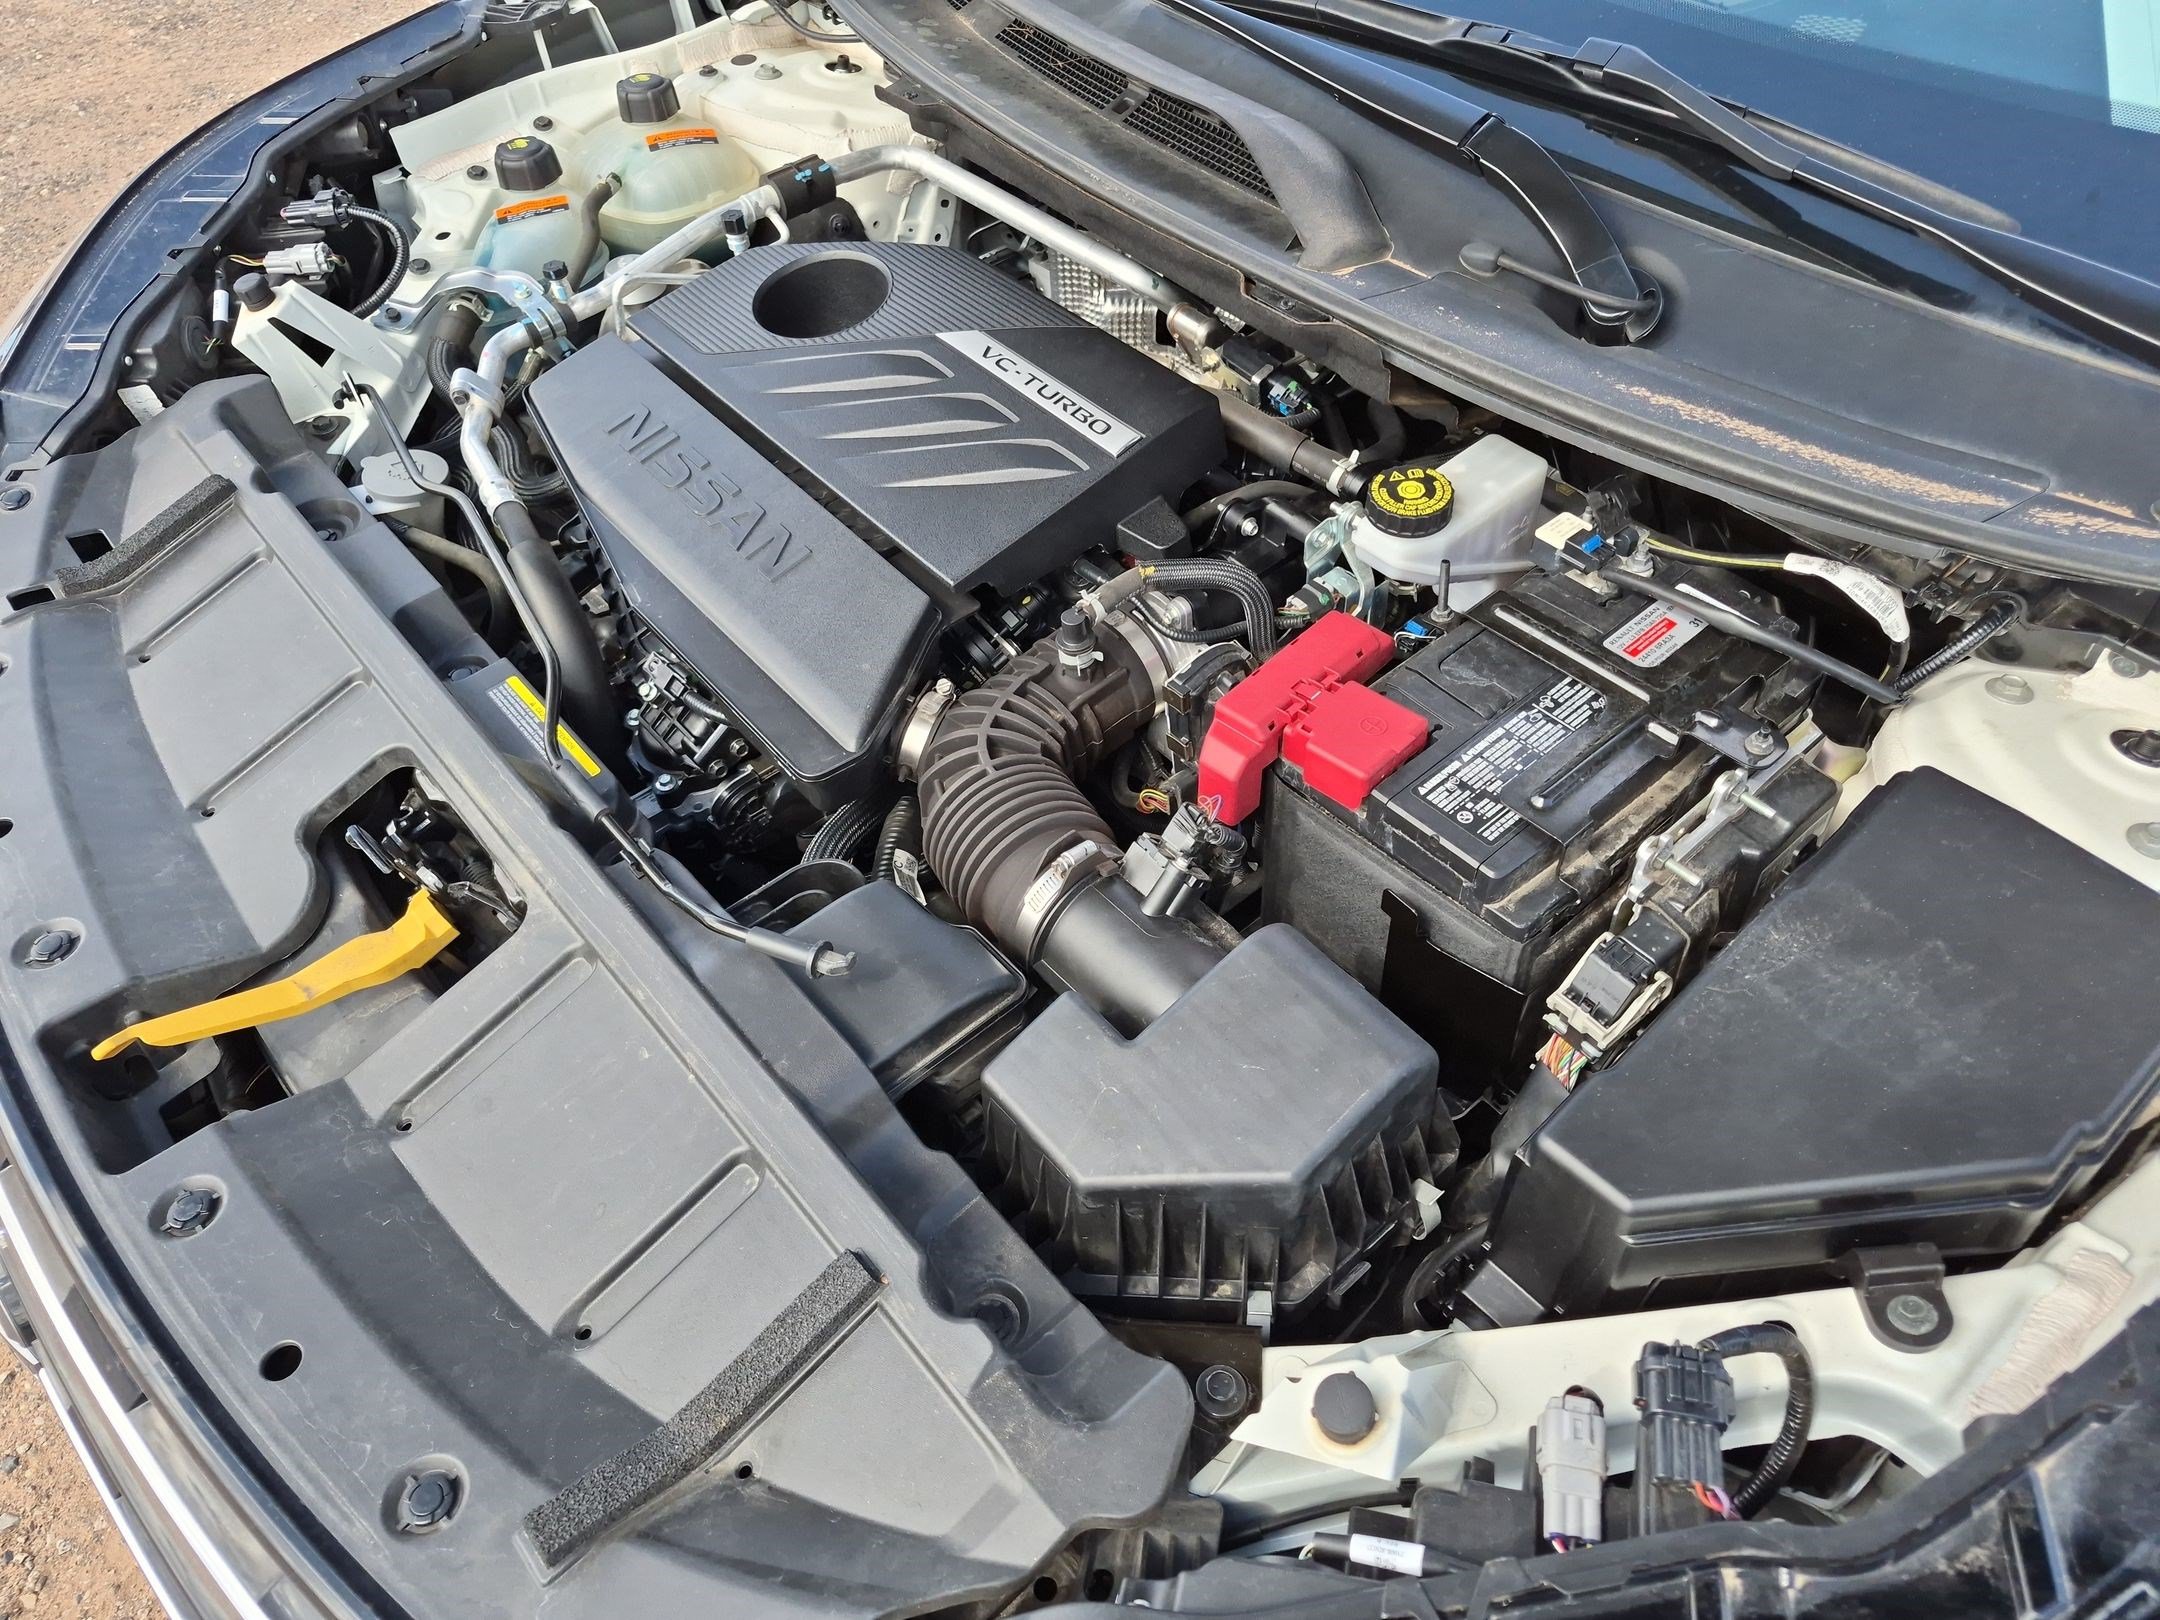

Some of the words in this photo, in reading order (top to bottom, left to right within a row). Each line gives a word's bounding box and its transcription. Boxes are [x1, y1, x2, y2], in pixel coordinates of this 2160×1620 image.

[981, 345, 1112, 435] VC-TURBO
[603, 402, 814, 583] NISSAN
[1608, 624, 1635, 646] RENAULT
[1633, 606, 1660, 626] NISSAN
[1688, 617, 1704, 628] 31
